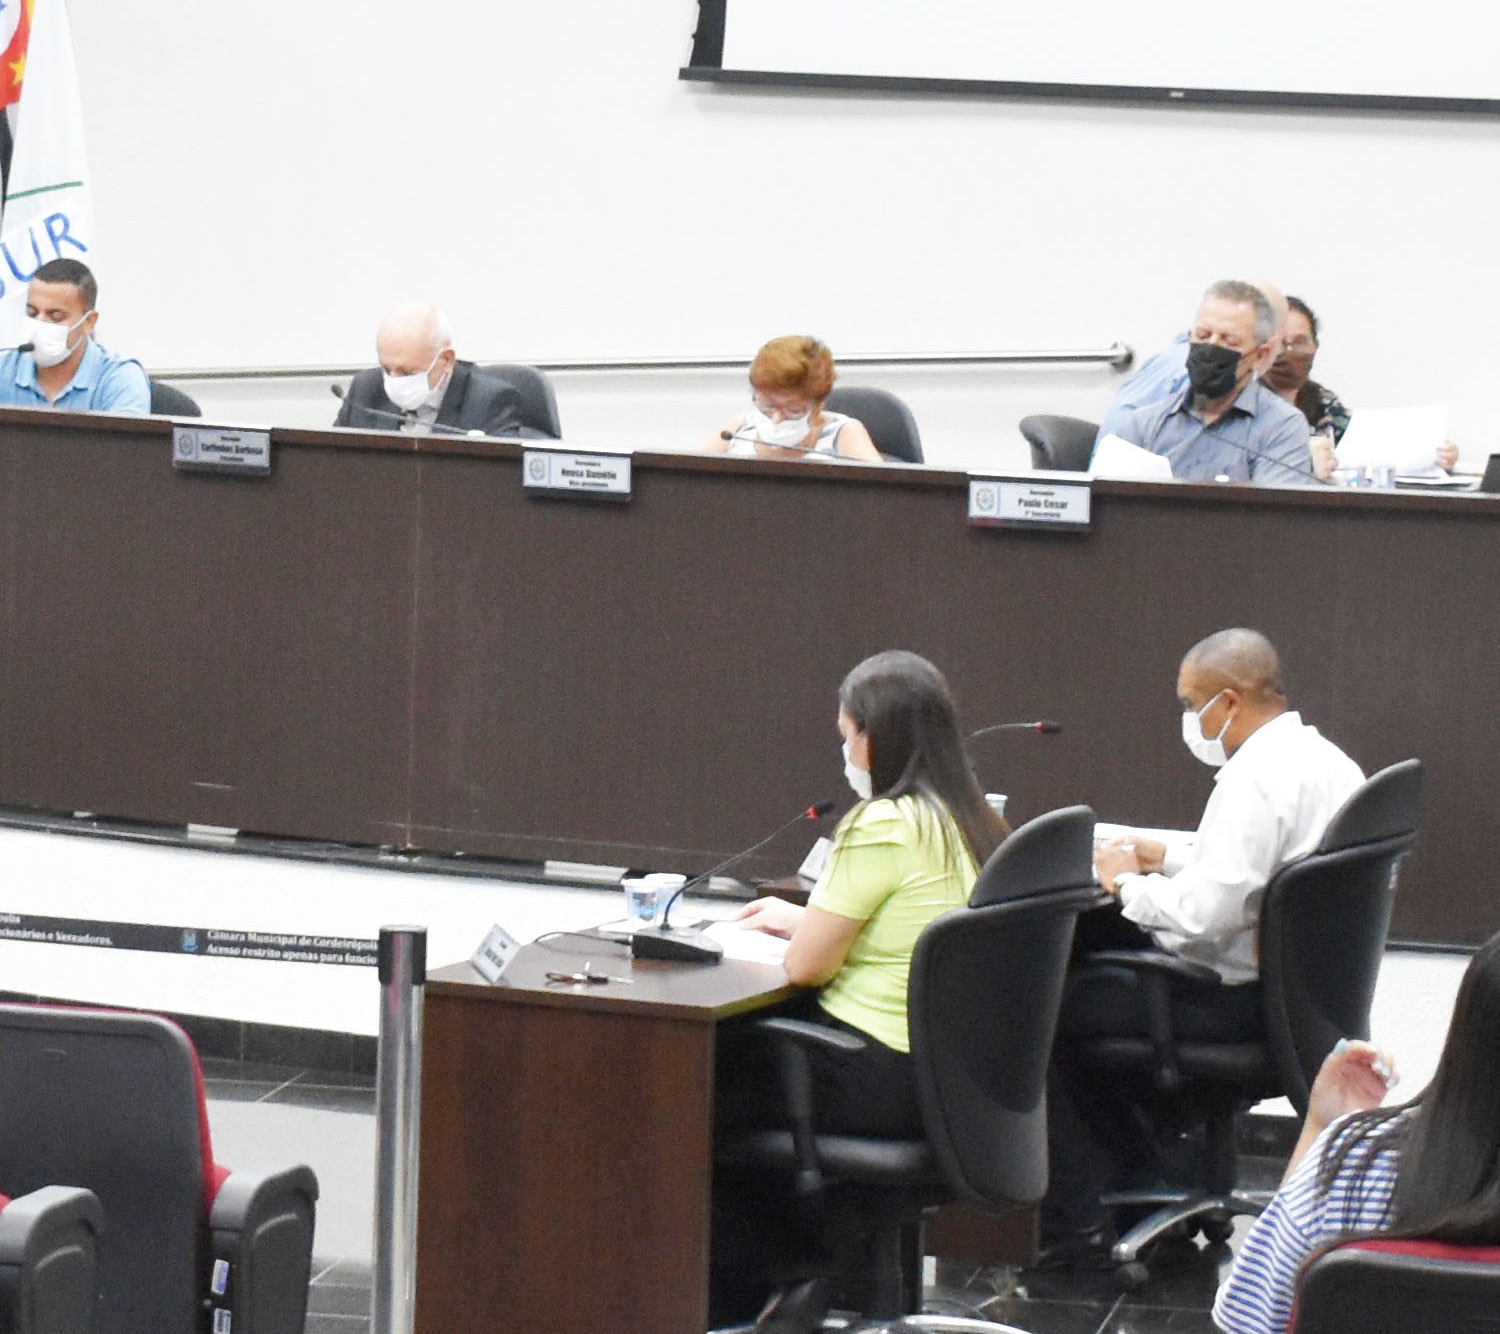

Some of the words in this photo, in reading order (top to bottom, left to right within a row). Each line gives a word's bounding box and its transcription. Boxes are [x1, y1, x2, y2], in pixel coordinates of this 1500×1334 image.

[207, 929, 246, 942] Câmara
[248, 931, 298, 946] Municipal
[300, 935, 312, 946] de
[313, 937, 378, 952] Cordeirópoli
[206, 944, 241, 955] Acesso
[242, 946, 281, 958] restrito
[282, 950, 318, 962] apenas
[320, 953, 343, 964] para
[344, 953, 378, 965] funcio
